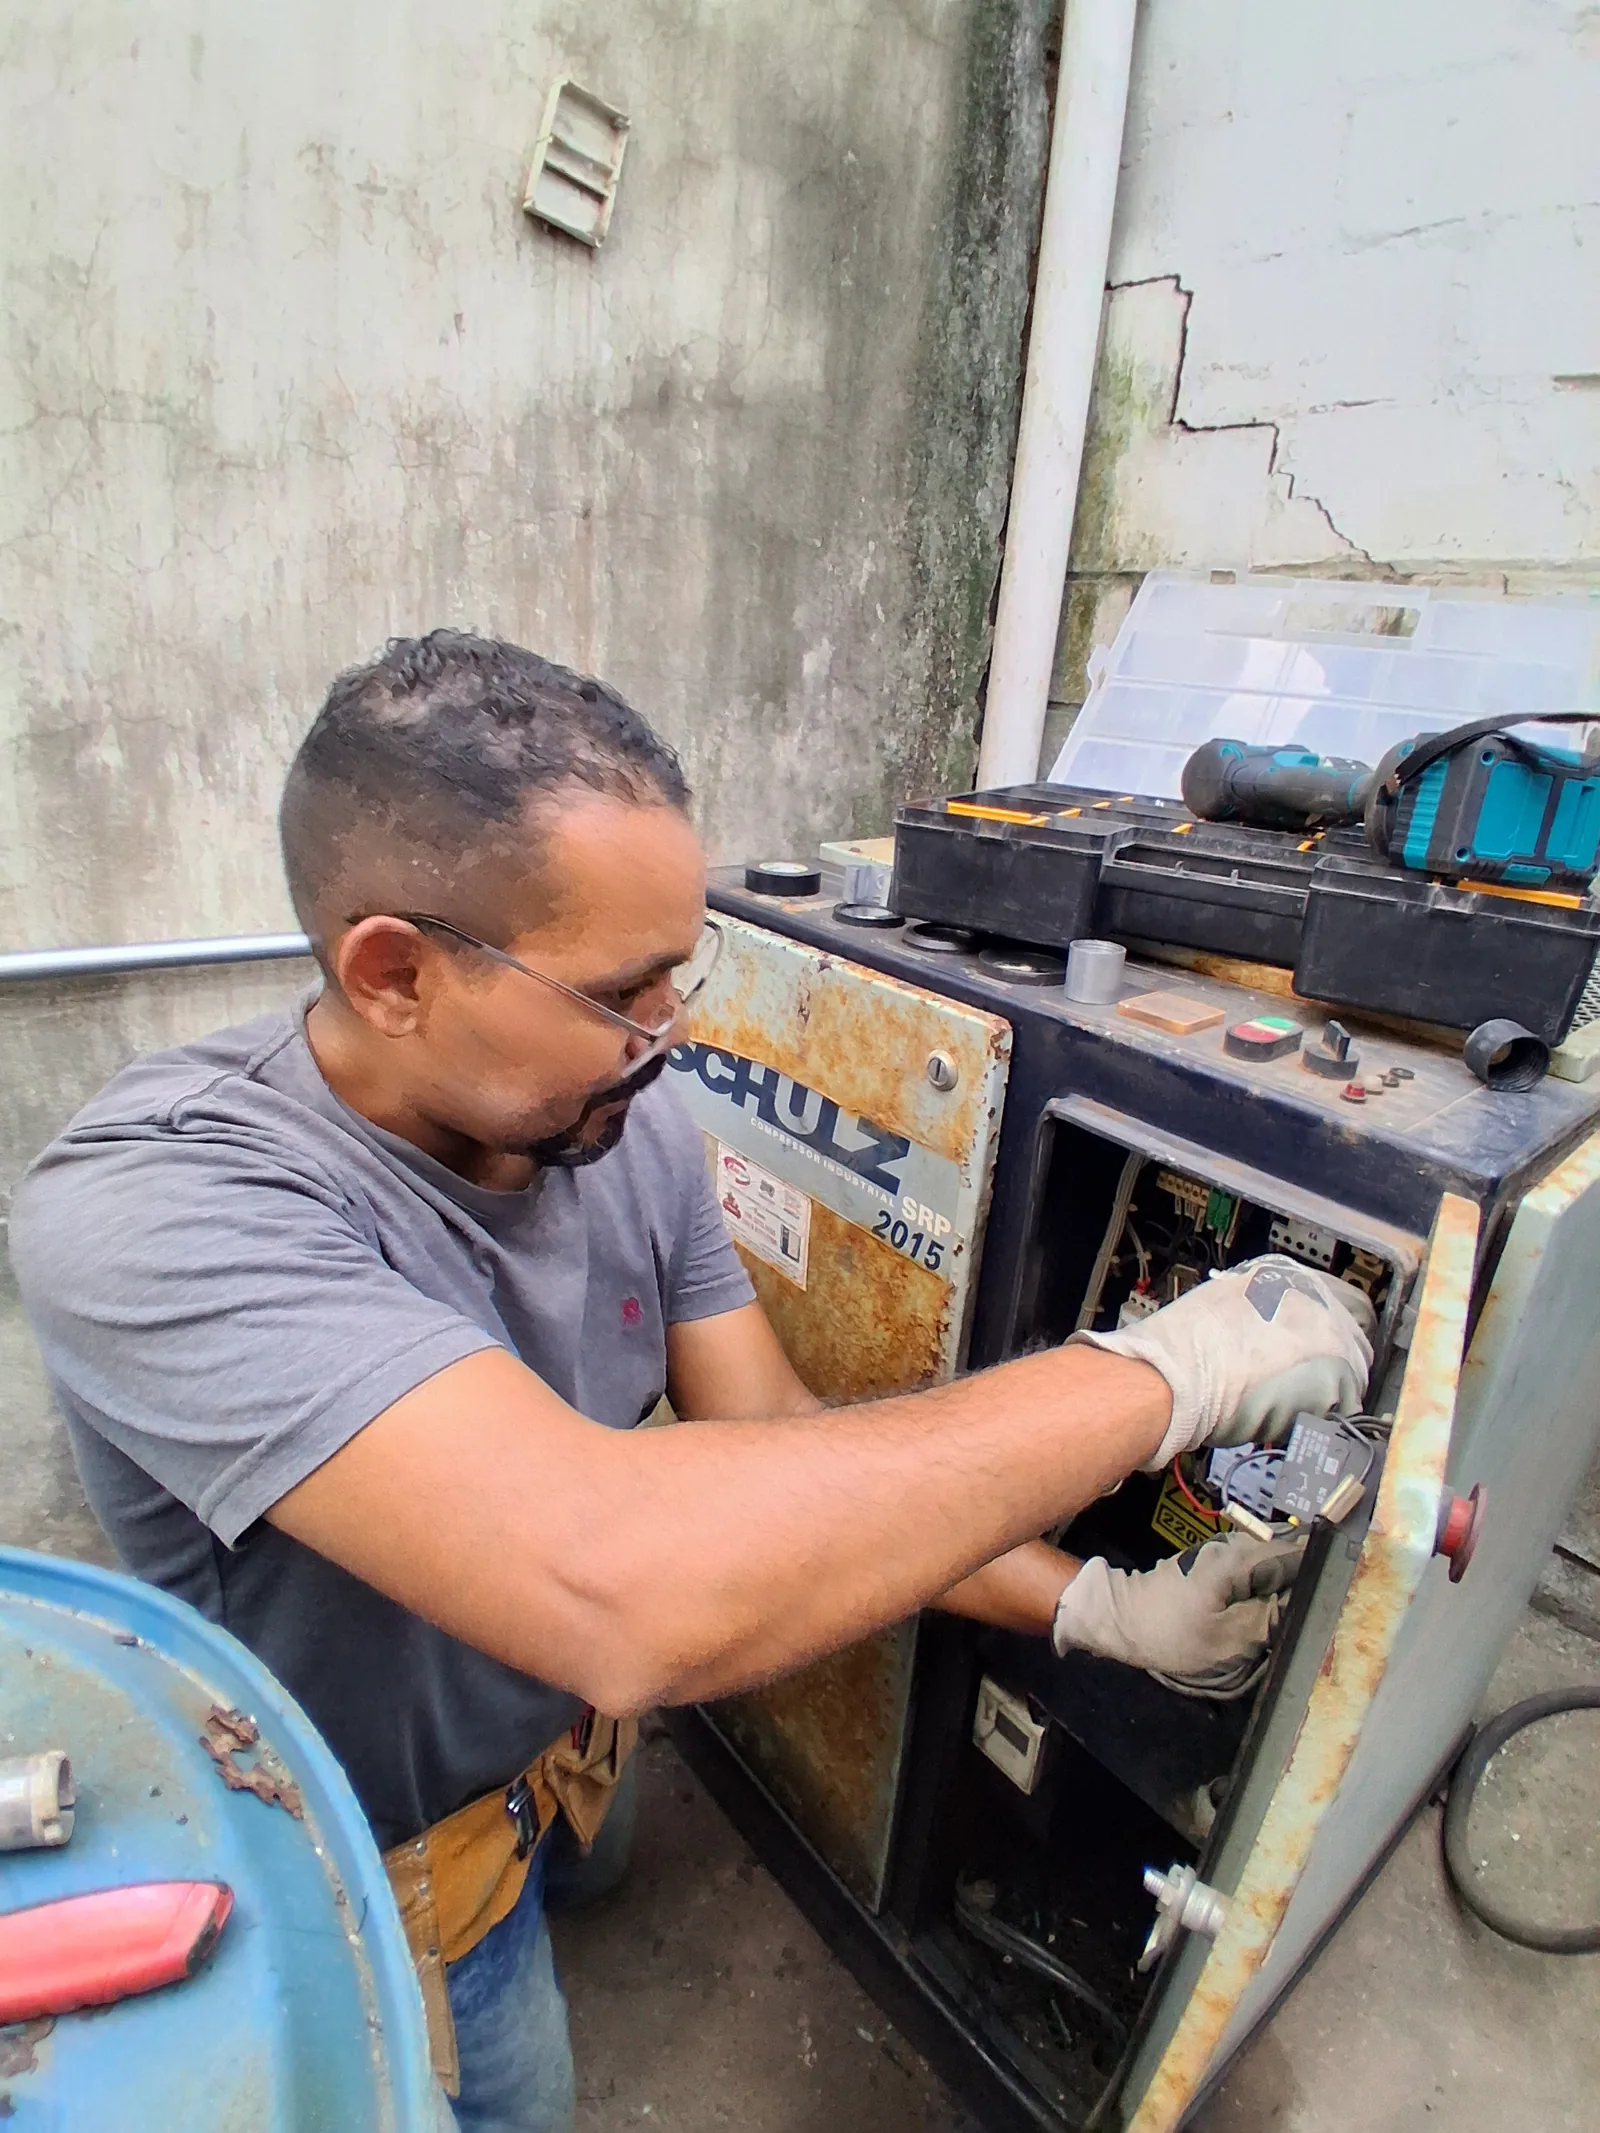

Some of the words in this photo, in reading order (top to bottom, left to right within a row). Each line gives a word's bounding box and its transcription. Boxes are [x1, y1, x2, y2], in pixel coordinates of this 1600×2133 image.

[751, 1117, 820, 1165] COMPRESSOR
[823, 1160, 895, 1208] INDUSTRIAL
[871, 1210, 945, 1271] 2015
[902, 1195, 951, 1237] SRP
